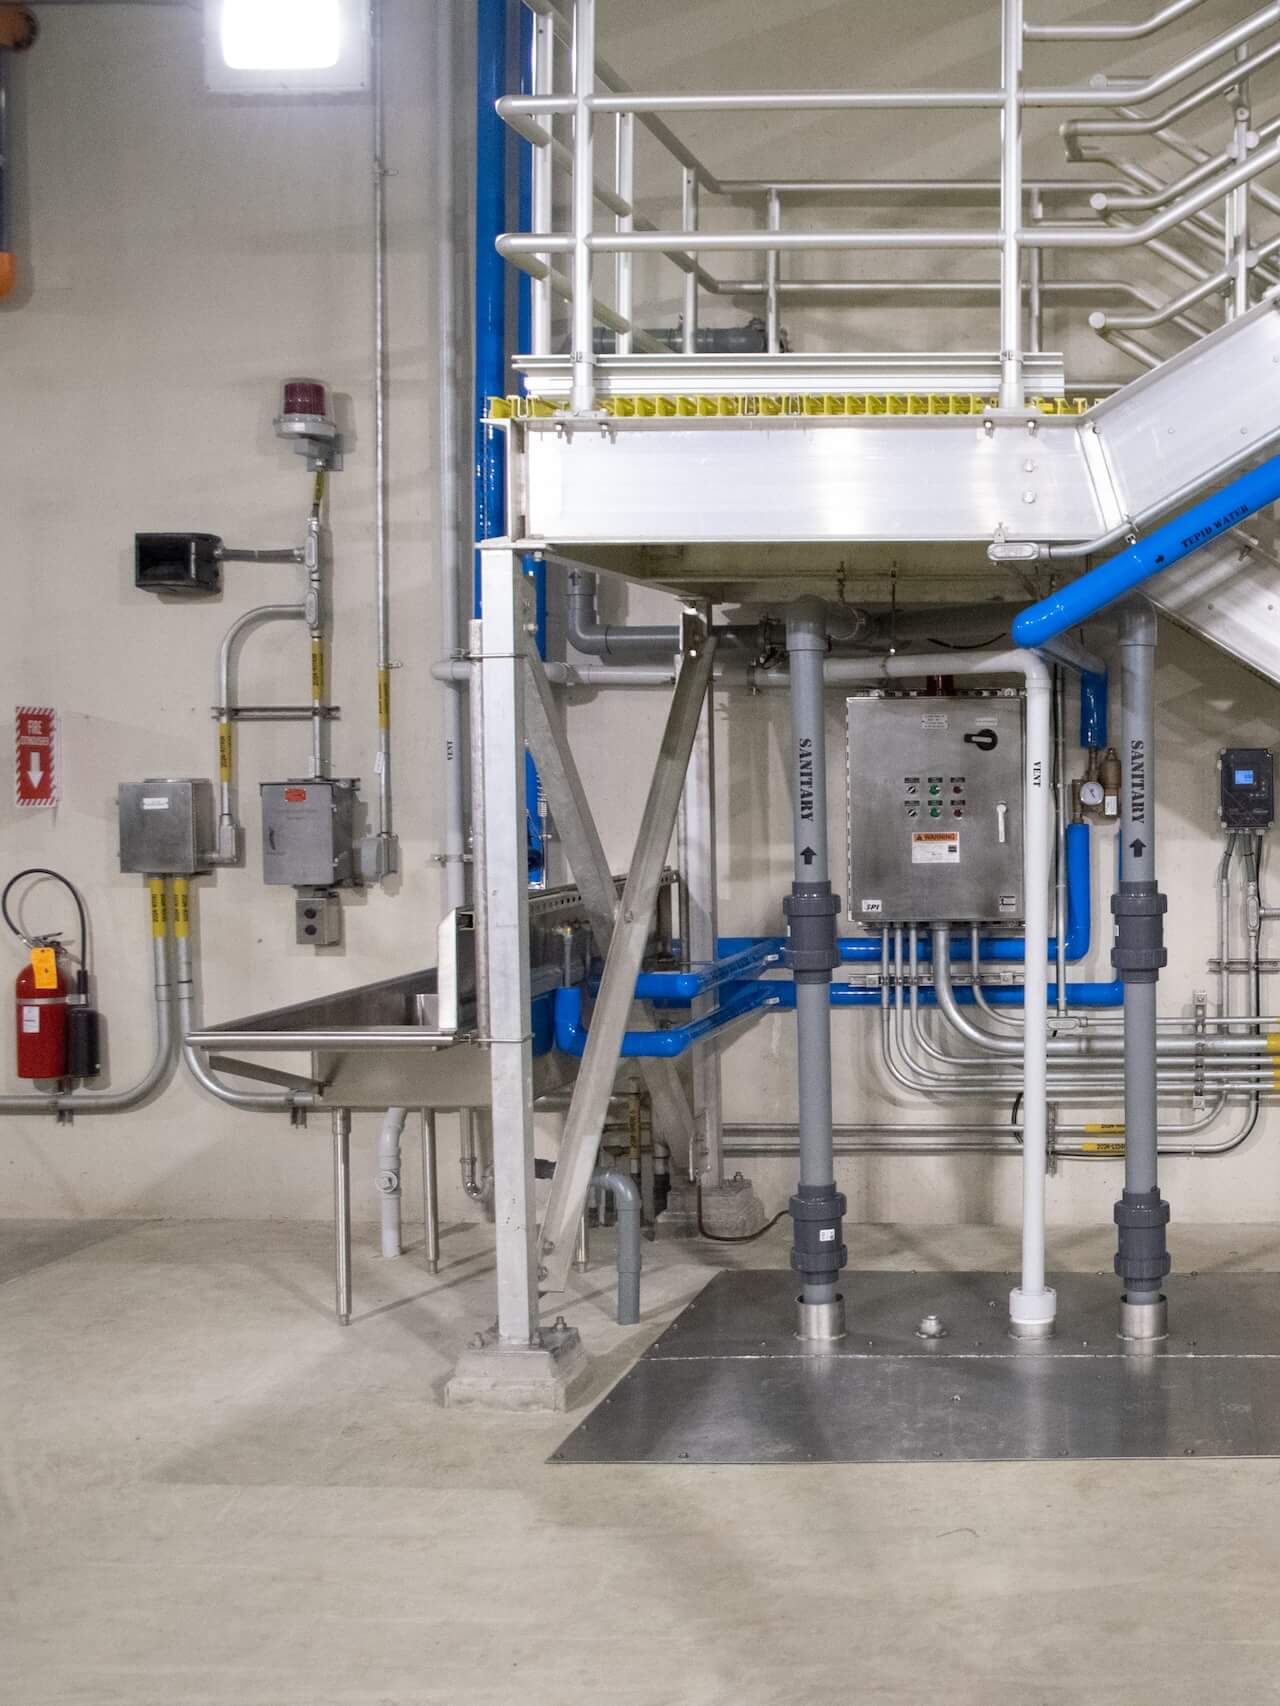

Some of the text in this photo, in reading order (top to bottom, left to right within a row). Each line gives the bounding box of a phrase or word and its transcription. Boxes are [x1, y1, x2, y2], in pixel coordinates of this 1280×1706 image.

[1181, 504, 1248, 548] TEPID WATER
[27, 720, 42, 735] FIRE
[799, 738, 814, 822] SANITARY
[1033, 761, 1041, 788] VENT
[1131, 740, 1145, 824] SANITARY
[924, 833, 955, 841] WARNING
